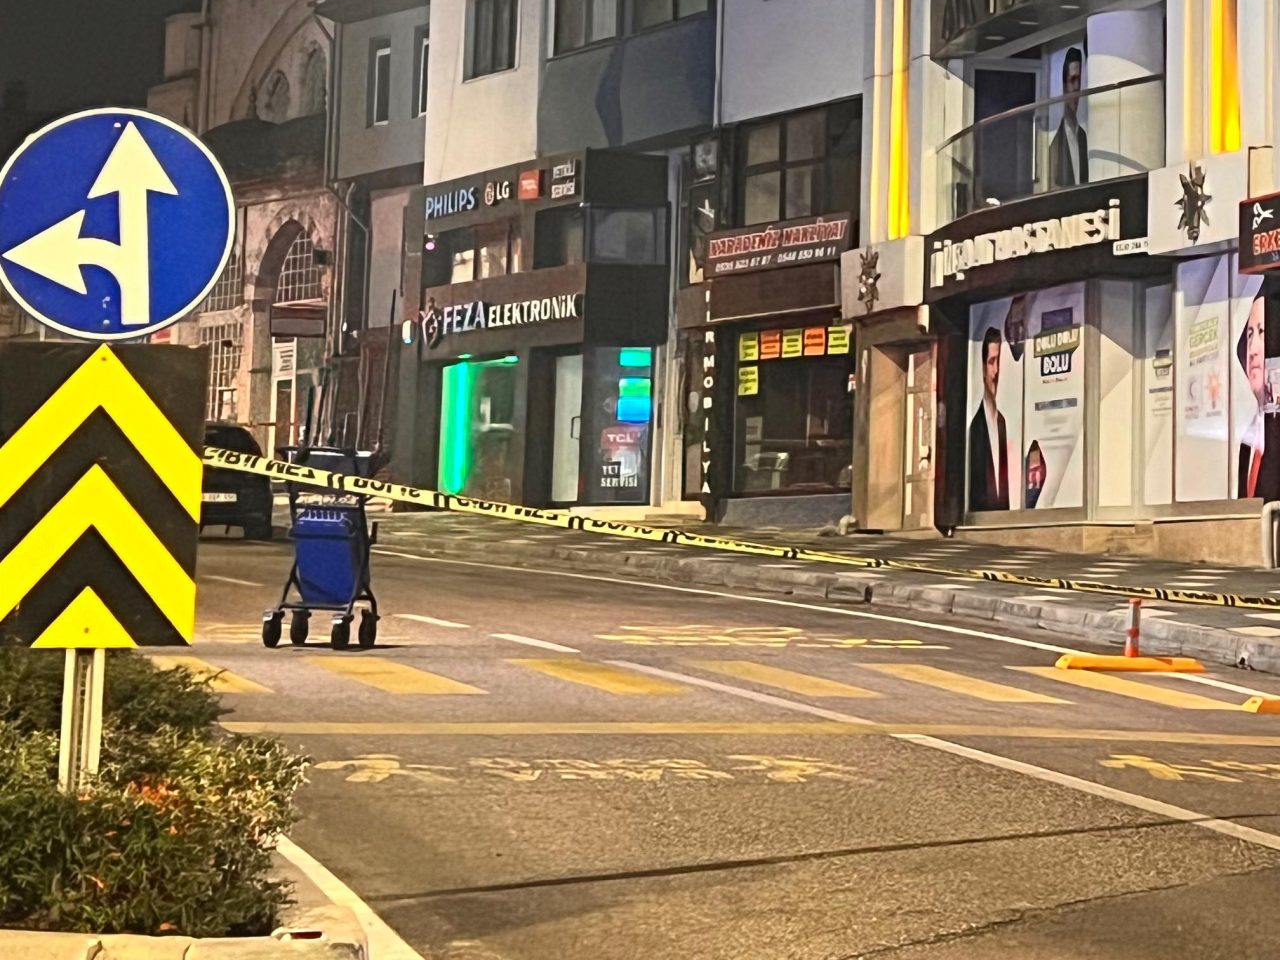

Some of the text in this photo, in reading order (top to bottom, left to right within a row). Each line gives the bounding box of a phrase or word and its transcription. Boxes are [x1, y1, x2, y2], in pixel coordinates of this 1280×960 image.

[426, 187, 476, 218] PHILIPS
[496, 181, 510, 200] LG
[442, 294, 577, 335] FEZA ELEKTRONİK
